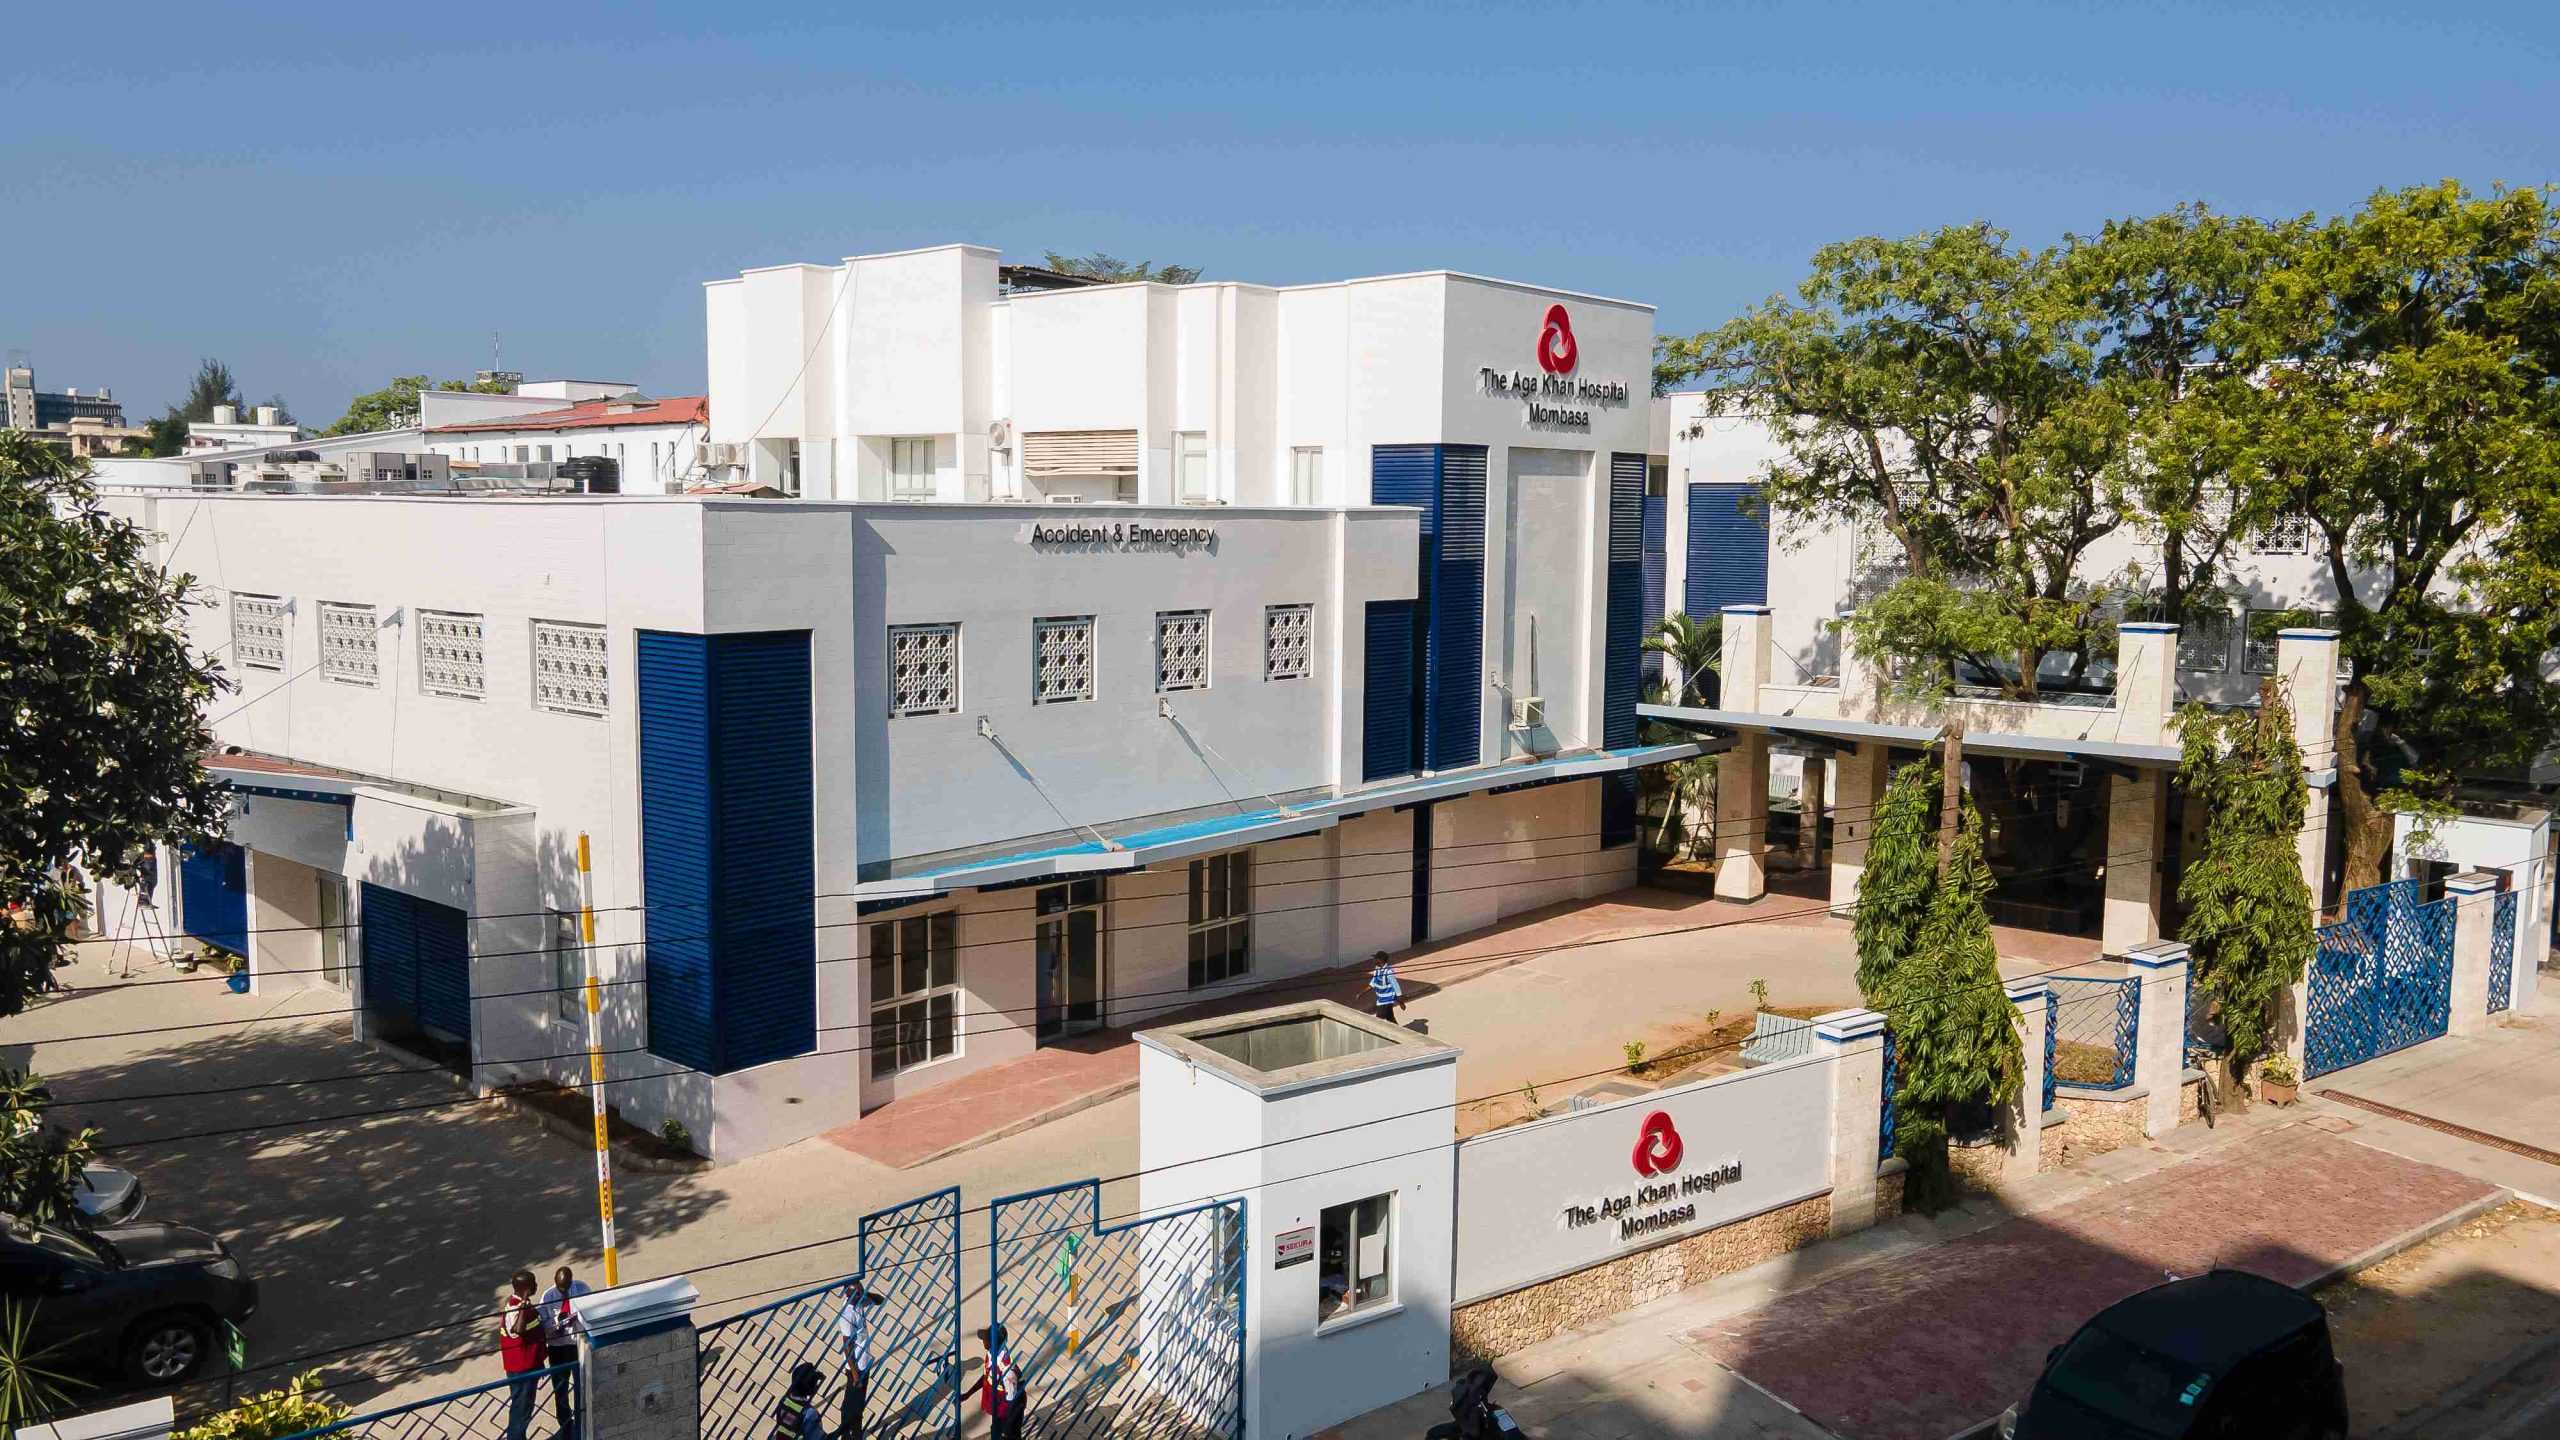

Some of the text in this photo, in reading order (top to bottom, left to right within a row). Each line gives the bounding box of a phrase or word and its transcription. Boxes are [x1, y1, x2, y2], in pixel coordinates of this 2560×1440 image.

[1480, 367, 1628, 401] The Aga Khan Hospital
[1529, 403, 1589, 426] Mombasa
[1032, 523, 1215, 547] Accident & Emergency
[1565, 1161, 1743, 1229] The Aga Khan Hospital
[1621, 1202, 1696, 1241] Mombasa
